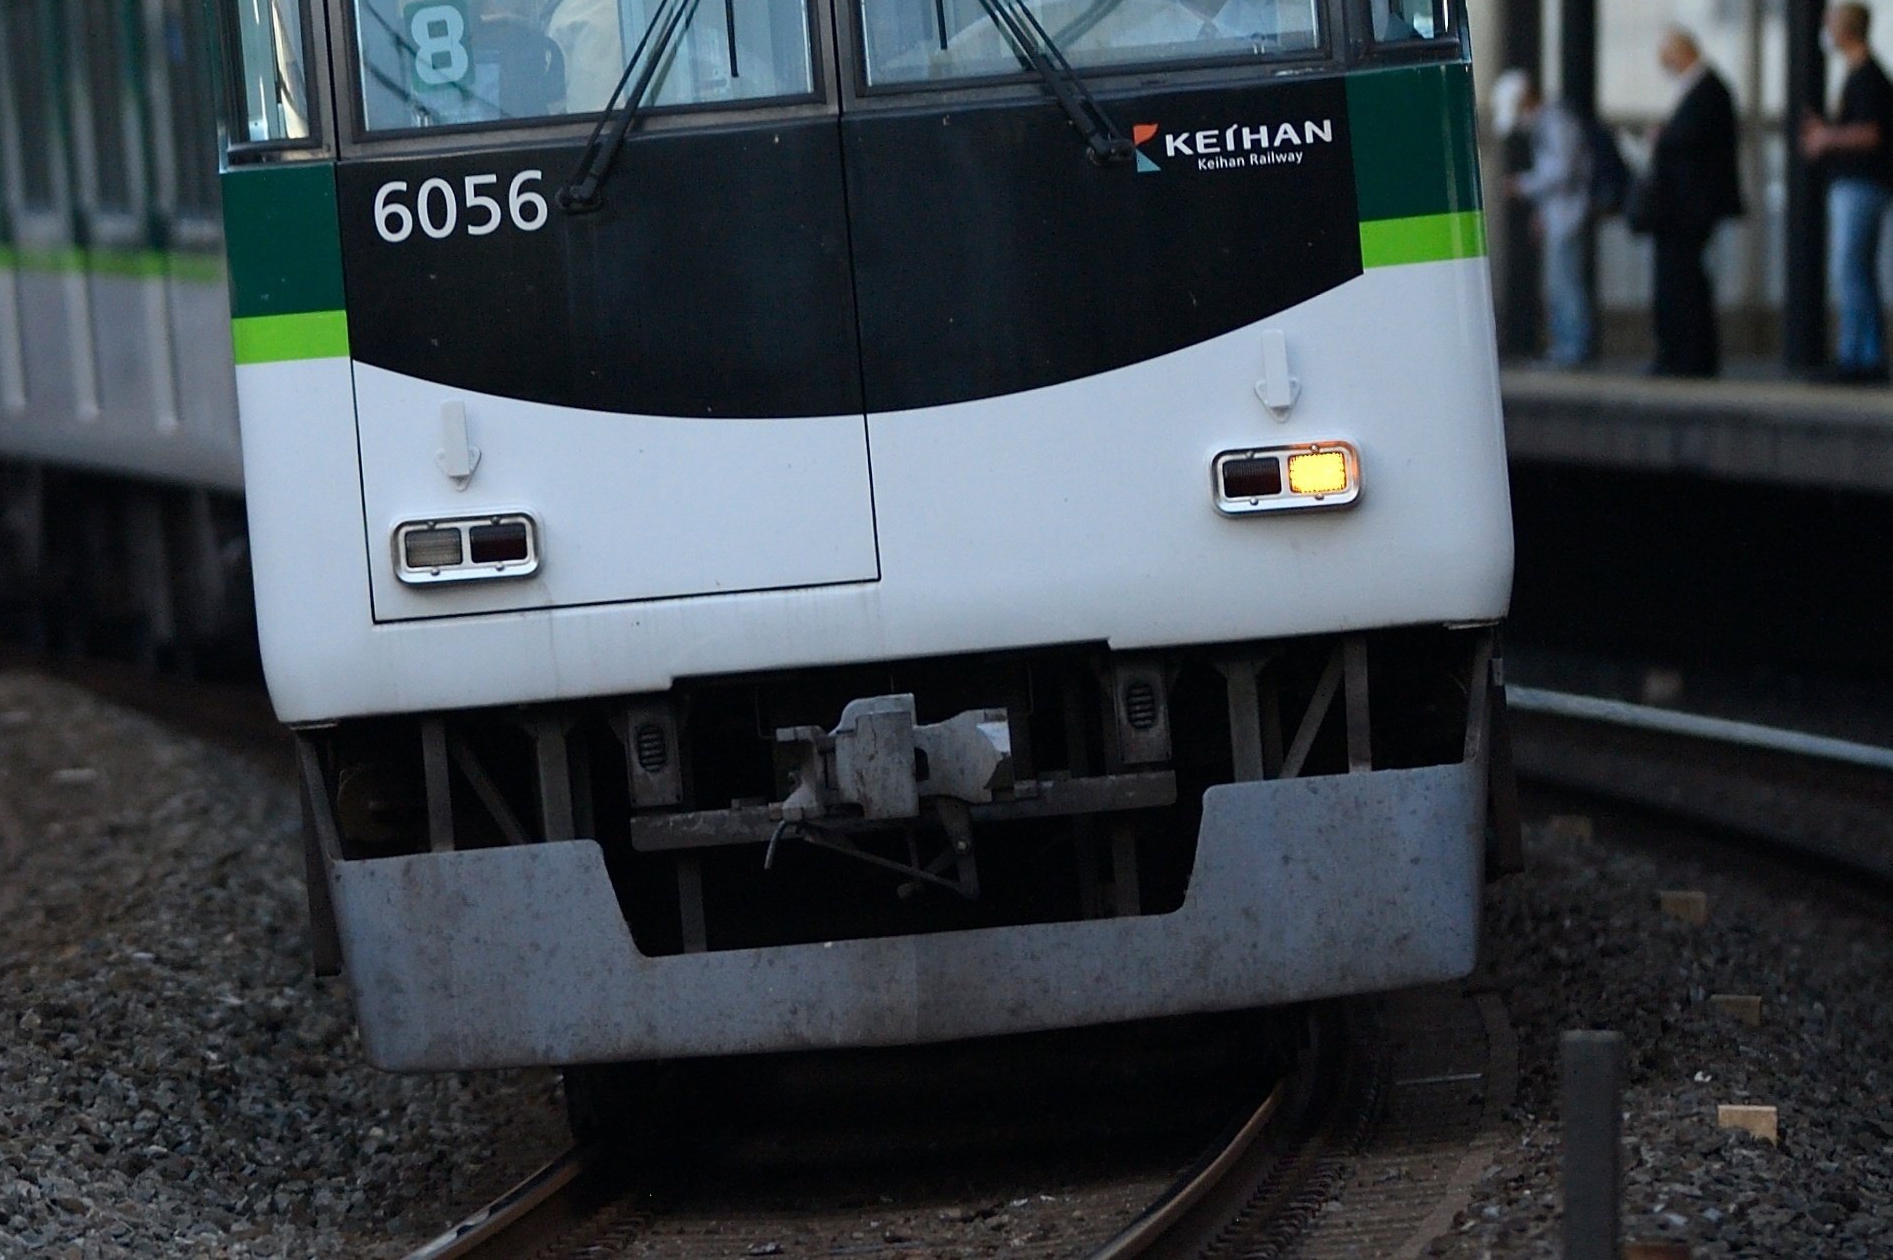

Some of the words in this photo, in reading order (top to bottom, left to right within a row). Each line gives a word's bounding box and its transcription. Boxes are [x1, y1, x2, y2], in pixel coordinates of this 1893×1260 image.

[411, 5, 469, 85] 8
[1165, 119, 1333, 157] KEIHAN
[1198, 154, 1245, 171] Keihan
[1250, 151, 1303, 166] Railway
[374, 169, 548, 243] 6056
